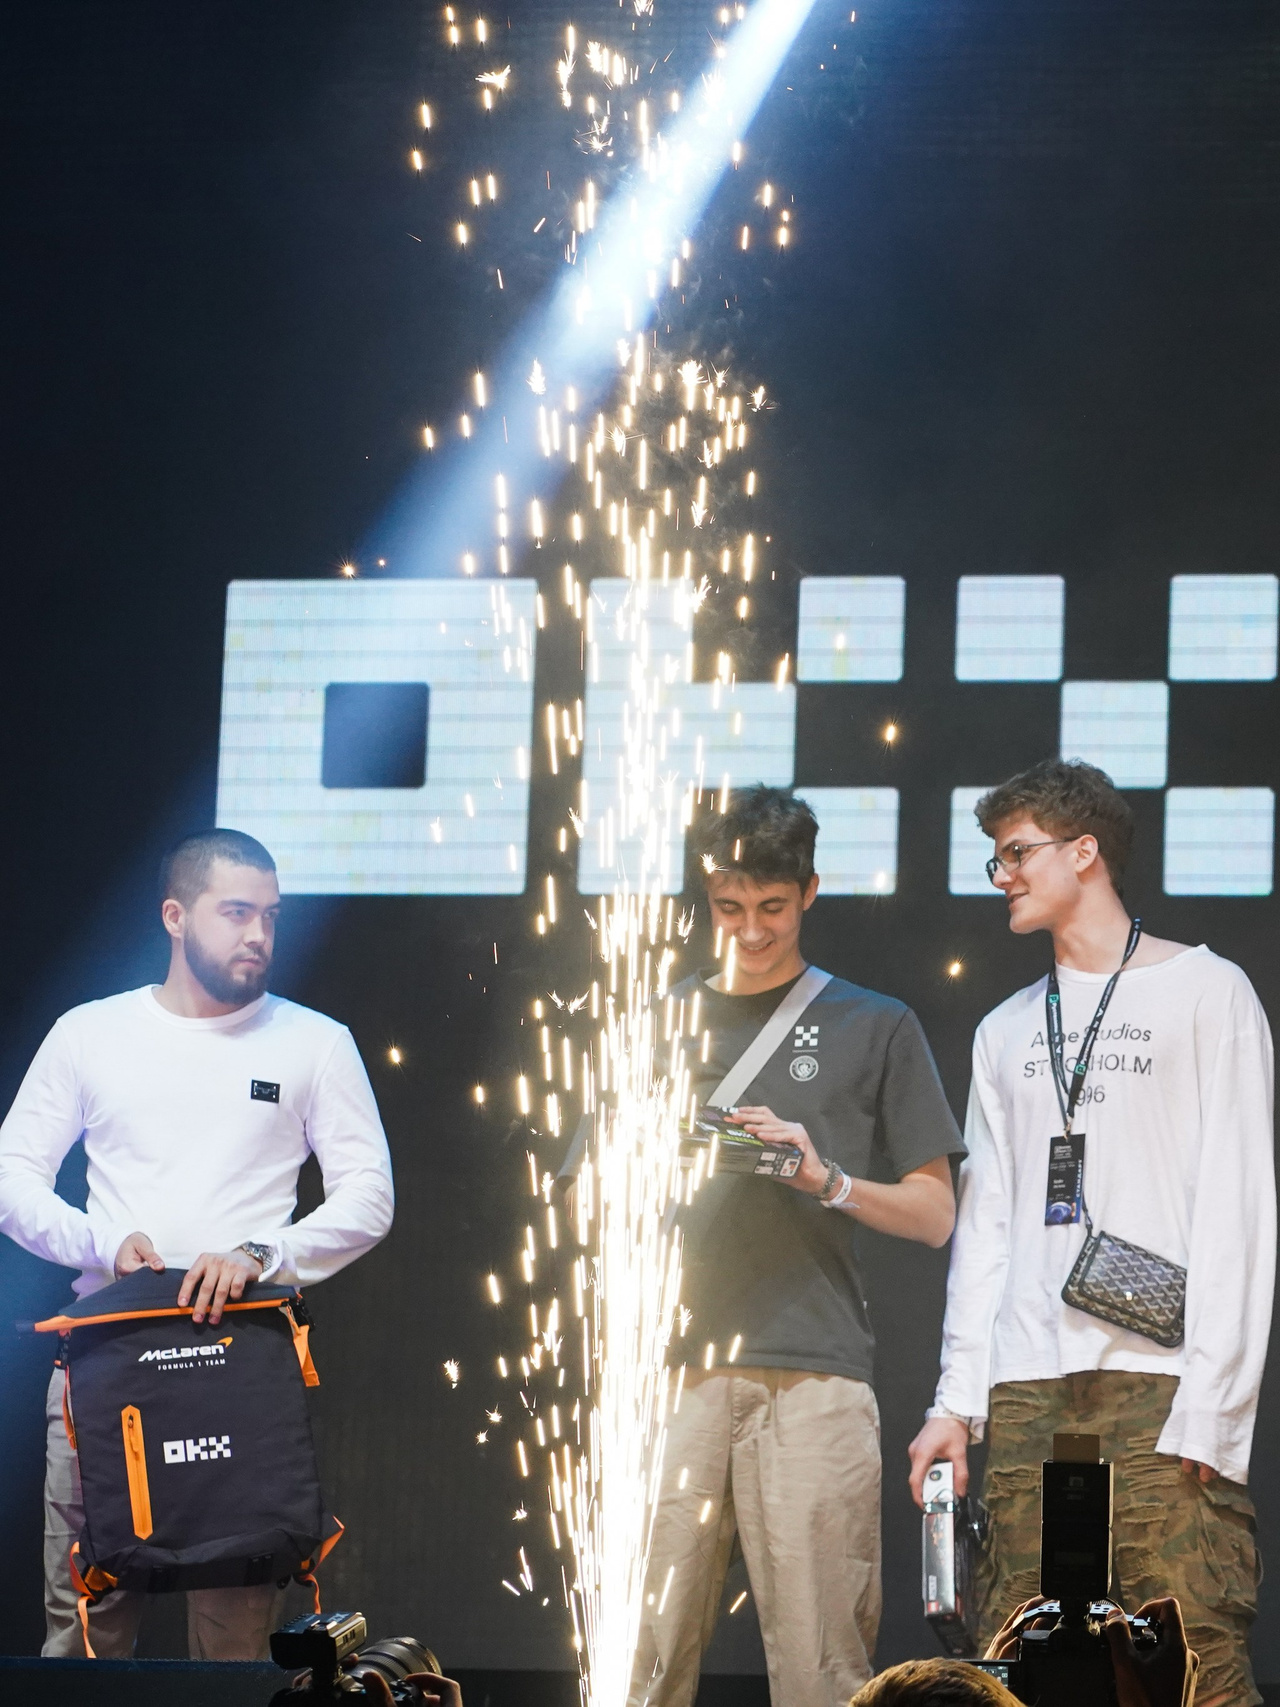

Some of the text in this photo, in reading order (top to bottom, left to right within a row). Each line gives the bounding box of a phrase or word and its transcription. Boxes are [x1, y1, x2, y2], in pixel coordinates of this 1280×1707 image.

[217, 574, 1280, 897] OKX
[138, 1344, 224, 1362] McLaren
[158, 1361, 194, 1371] FORMULA
[205, 1358, 226, 1367] TEAM
[163, 1435, 232, 1464] OKX
